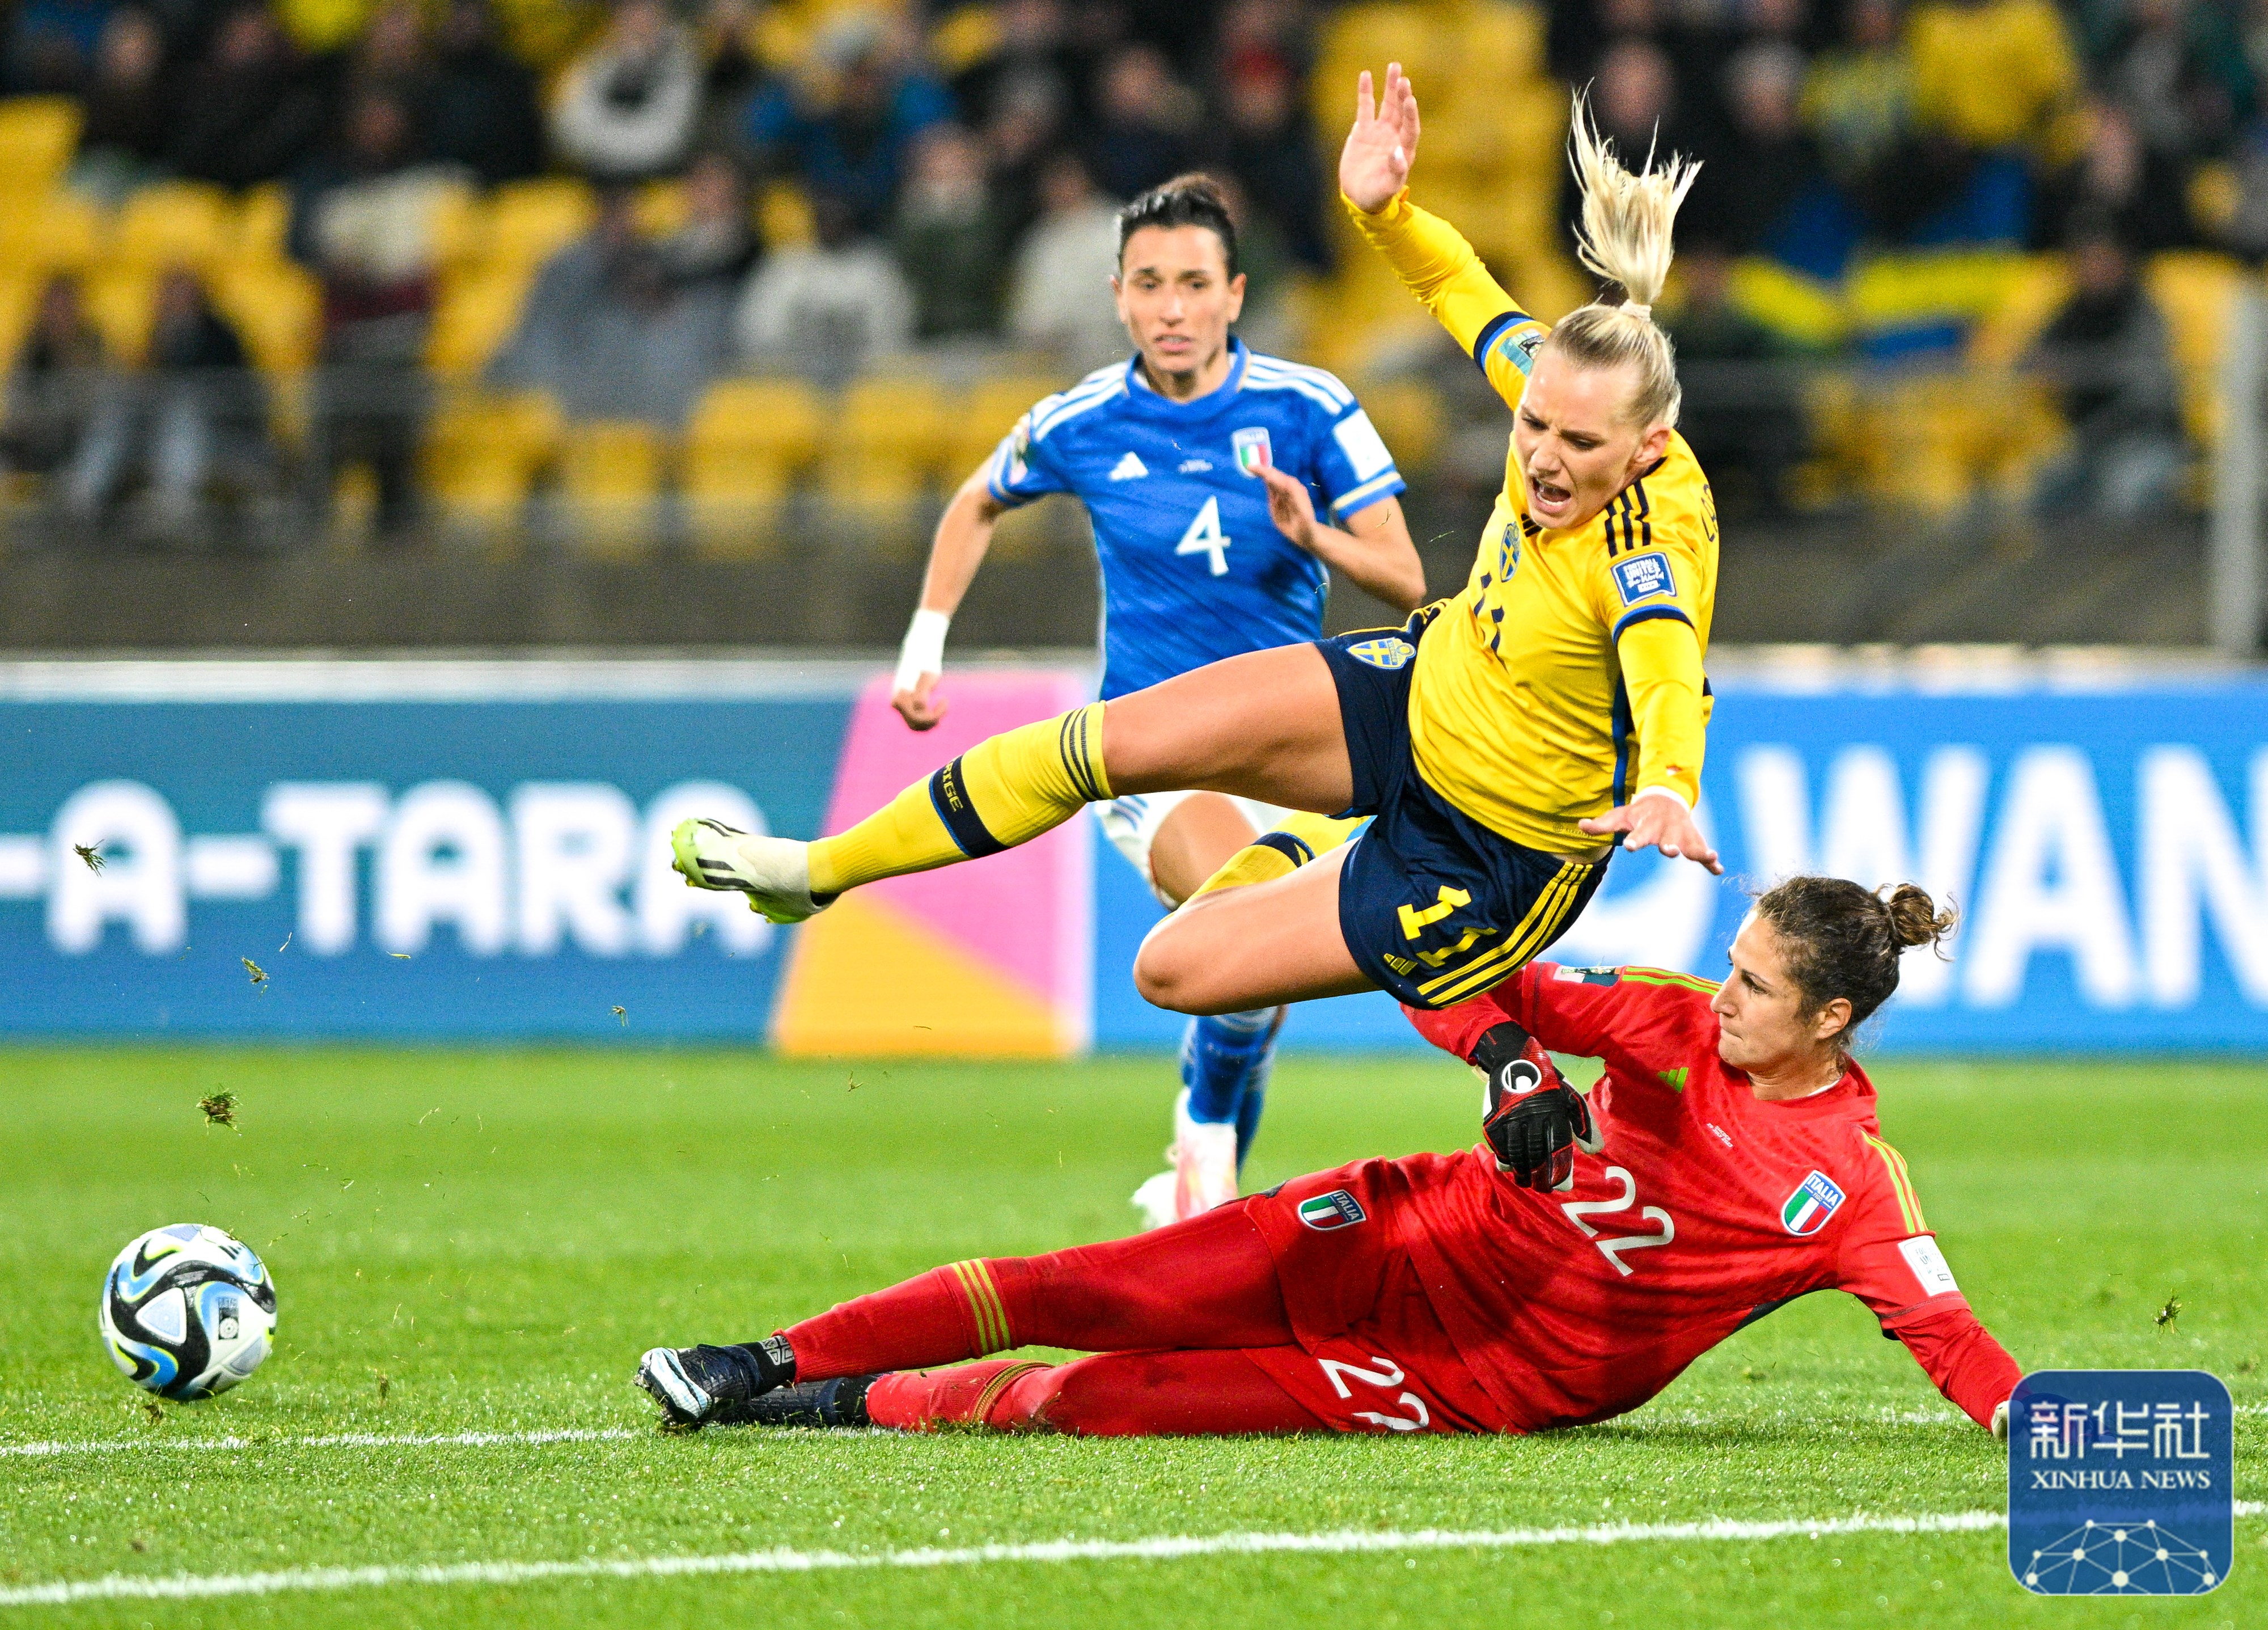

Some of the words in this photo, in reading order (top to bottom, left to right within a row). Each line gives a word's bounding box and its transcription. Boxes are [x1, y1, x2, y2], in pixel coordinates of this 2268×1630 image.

[1175, 495, 1231, 577] 4
[1625, 563, 1661, 580] UNITES
[1397, 885, 1499, 968] 11
[1721, 1137, 1733, 1147] 2023
[1334, 1192, 1360, 1220] ITALIA
[1806, 1175, 1839, 1206] ITALIA
[1560, 1166, 1675, 1276] 22
[1317, 1355, 1429, 1431] 22
